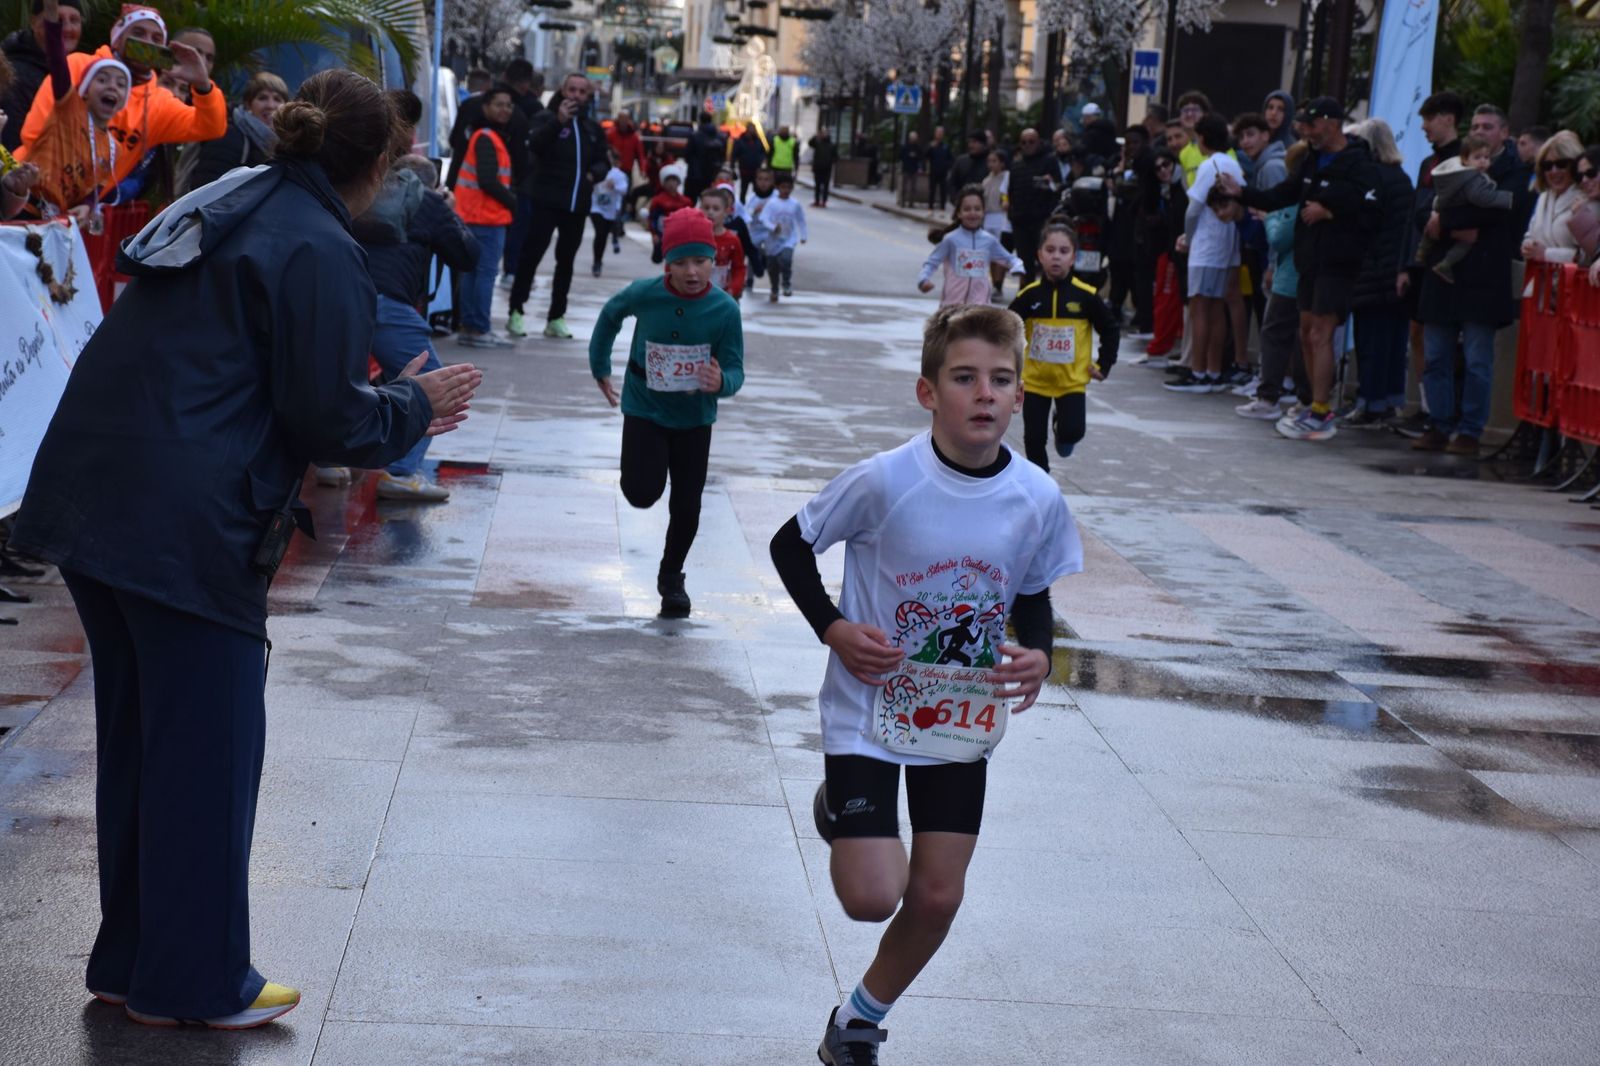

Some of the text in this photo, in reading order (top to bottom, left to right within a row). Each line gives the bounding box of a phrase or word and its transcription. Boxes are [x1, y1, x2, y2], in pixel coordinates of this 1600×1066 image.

[1047, 339, 1071, 352] 348
[909, 571, 924, 585] San
[926, 559, 958, 578] Silvestre
[961, 555, 991, 573] Ciudad
[933, 592, 948, 601] San
[952, 591, 978, 602] Silvestre
[949, 683, 961, 693] San
[934, 698, 996, 733] 614
[931, 730, 951, 739] Daniel
[952, 733, 975, 744] Obispo
